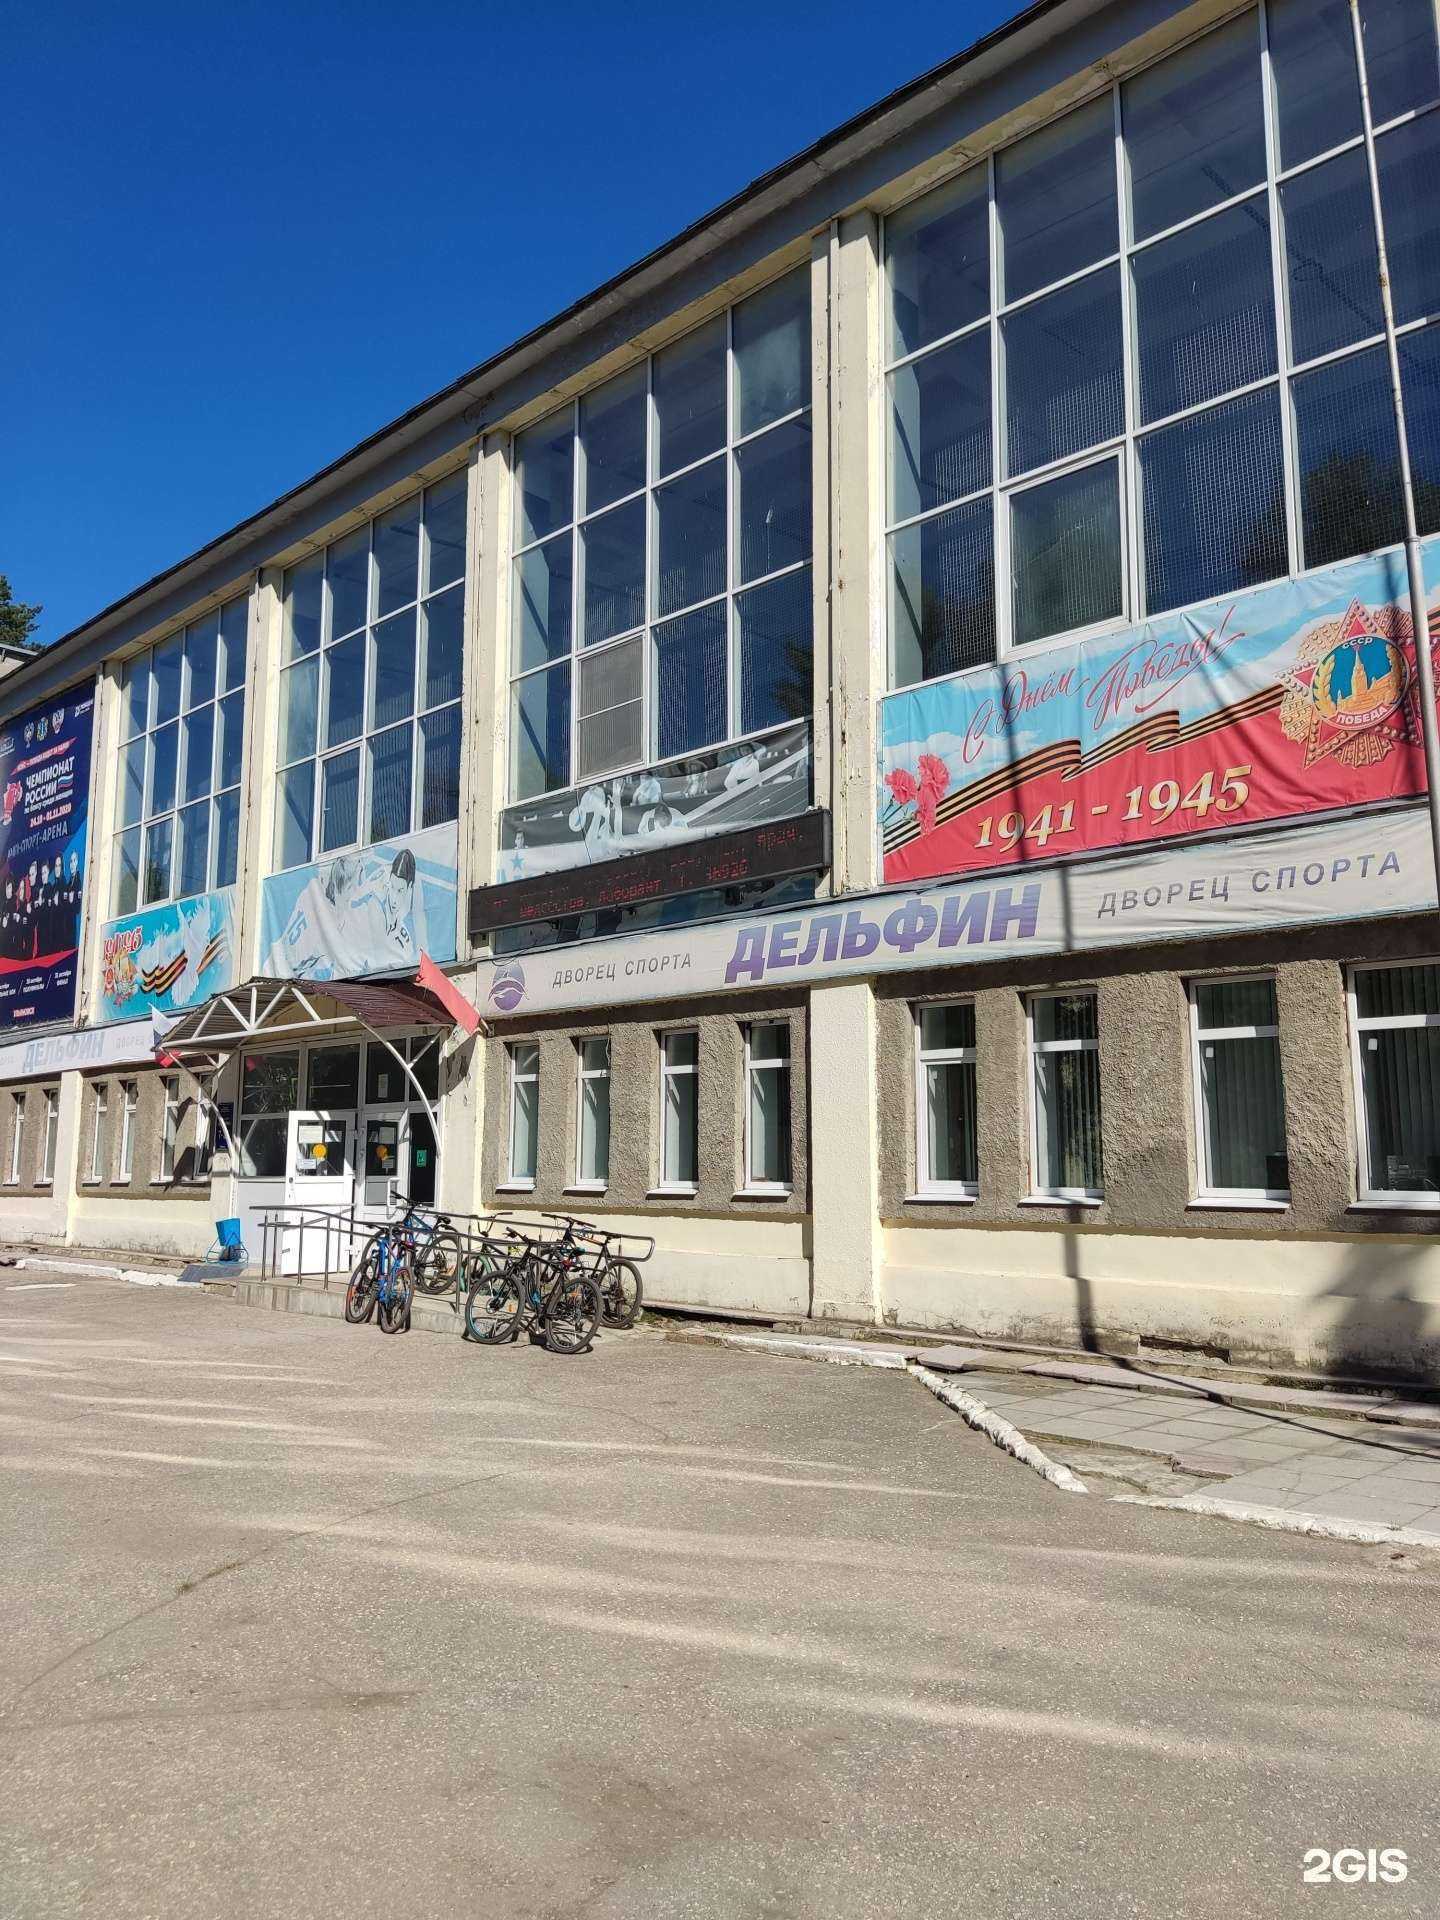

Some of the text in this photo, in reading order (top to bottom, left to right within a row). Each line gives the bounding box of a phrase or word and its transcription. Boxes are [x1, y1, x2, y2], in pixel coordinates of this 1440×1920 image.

[1342, 636, 1373, 650] СССР
[1336, 706, 1388, 724] ПОБЕДА
[26, 756, 75, 789] ЧЕМПИОНАТ
[25, 780, 57, 807] РОССИИ
[973, 804, 1076, 853] 1941
[1120, 764, 1252, 826] 1945
[724, 850, 1401, 984] ДЕЛЬФИН ДВОРЕЦ СПОРТА
[552, 953, 692, 989] ДВОРЕЦ СПОРТА
[22, 1031, 106, 1073] ДЕЛЬФИН
